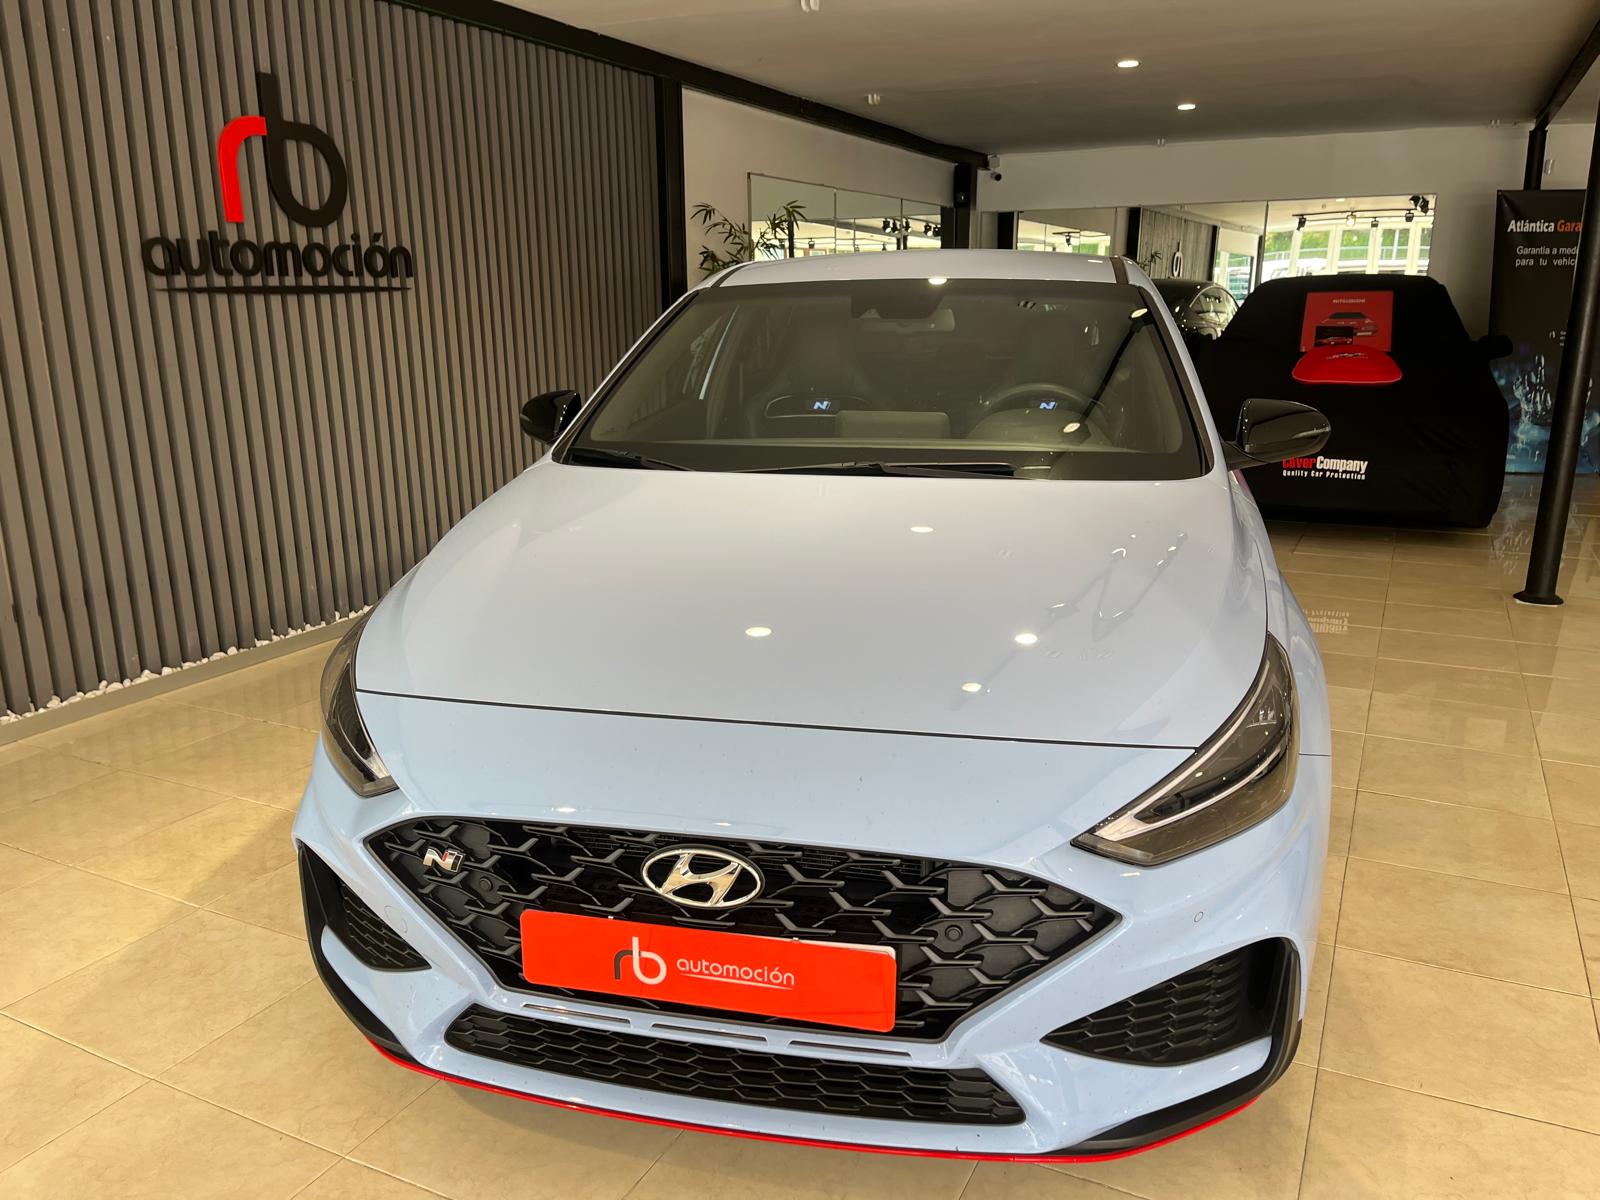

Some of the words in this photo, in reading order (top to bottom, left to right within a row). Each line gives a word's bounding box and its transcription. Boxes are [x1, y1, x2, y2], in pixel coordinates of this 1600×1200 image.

[216, 71, 348, 228] rb
[1507, 219, 1555, 232] Atlántica
[141, 230, 414, 278] automoción
[1515, 258, 1534, 269] para
[1539, 257, 1548, 266] tu
[1282, 469, 1308, 477] Quality
[1325, 471, 1366, 480] Protection
[613, 936, 667, 985] rb
[676, 958, 795, 987] automoción
